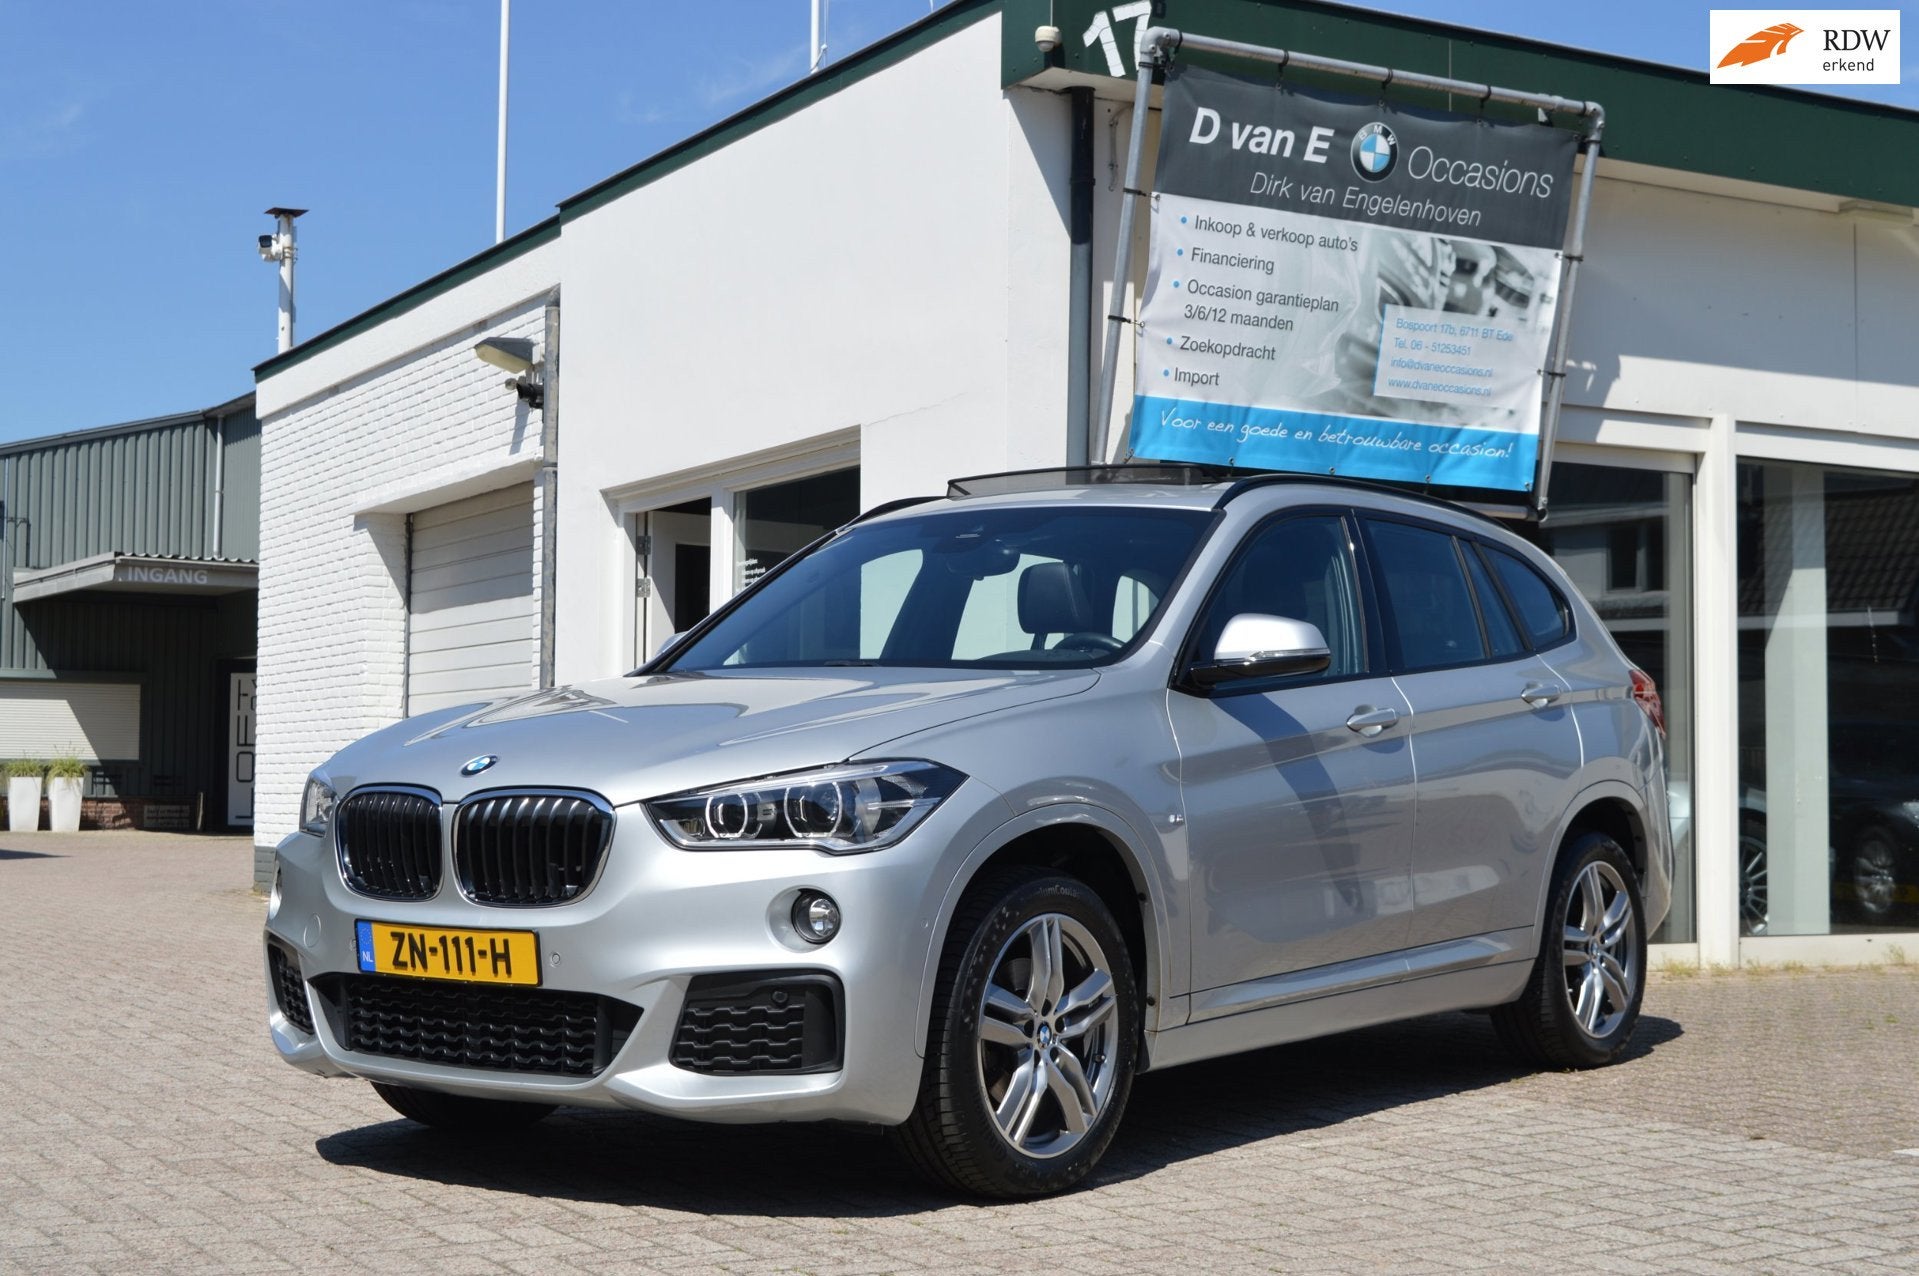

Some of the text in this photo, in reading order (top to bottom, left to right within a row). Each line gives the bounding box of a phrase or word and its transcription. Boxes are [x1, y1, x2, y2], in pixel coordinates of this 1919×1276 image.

[1082, 0, 1152, 77] 17
[1189, 107, 1554, 198] D van E BMW Occasions
[1250, 171, 1482, 227] Dirk van Engelenhoven
[1194, 215, 1358, 252] Inkoop & verkoop auto's
[1191, 247, 1275, 275] Financiering
[1187, 279, 1339, 312] Occasion garantieplan
[1184, 303, 1294, 332] 3/6/12 maanden
[1396, 318, 1437, 333] Bospoort
[1481, 328, 1495, 340] BT
[1179, 335, 1276, 361] Zoekopdracht
[1174, 367, 1220, 387] Import
[1391, 357, 1493, 378] info@dvaneoccasions.nl
[1388, 378, 1491, 397] www.dvaneoccasions.nl
[1160, 407, 1514, 459] Voor een goede en betrouwbare occasion!
[128, 566, 208, 585] INGANG
[362, 951, 374, 963] NL
[390, 931, 512, 978] ZN-111-H
